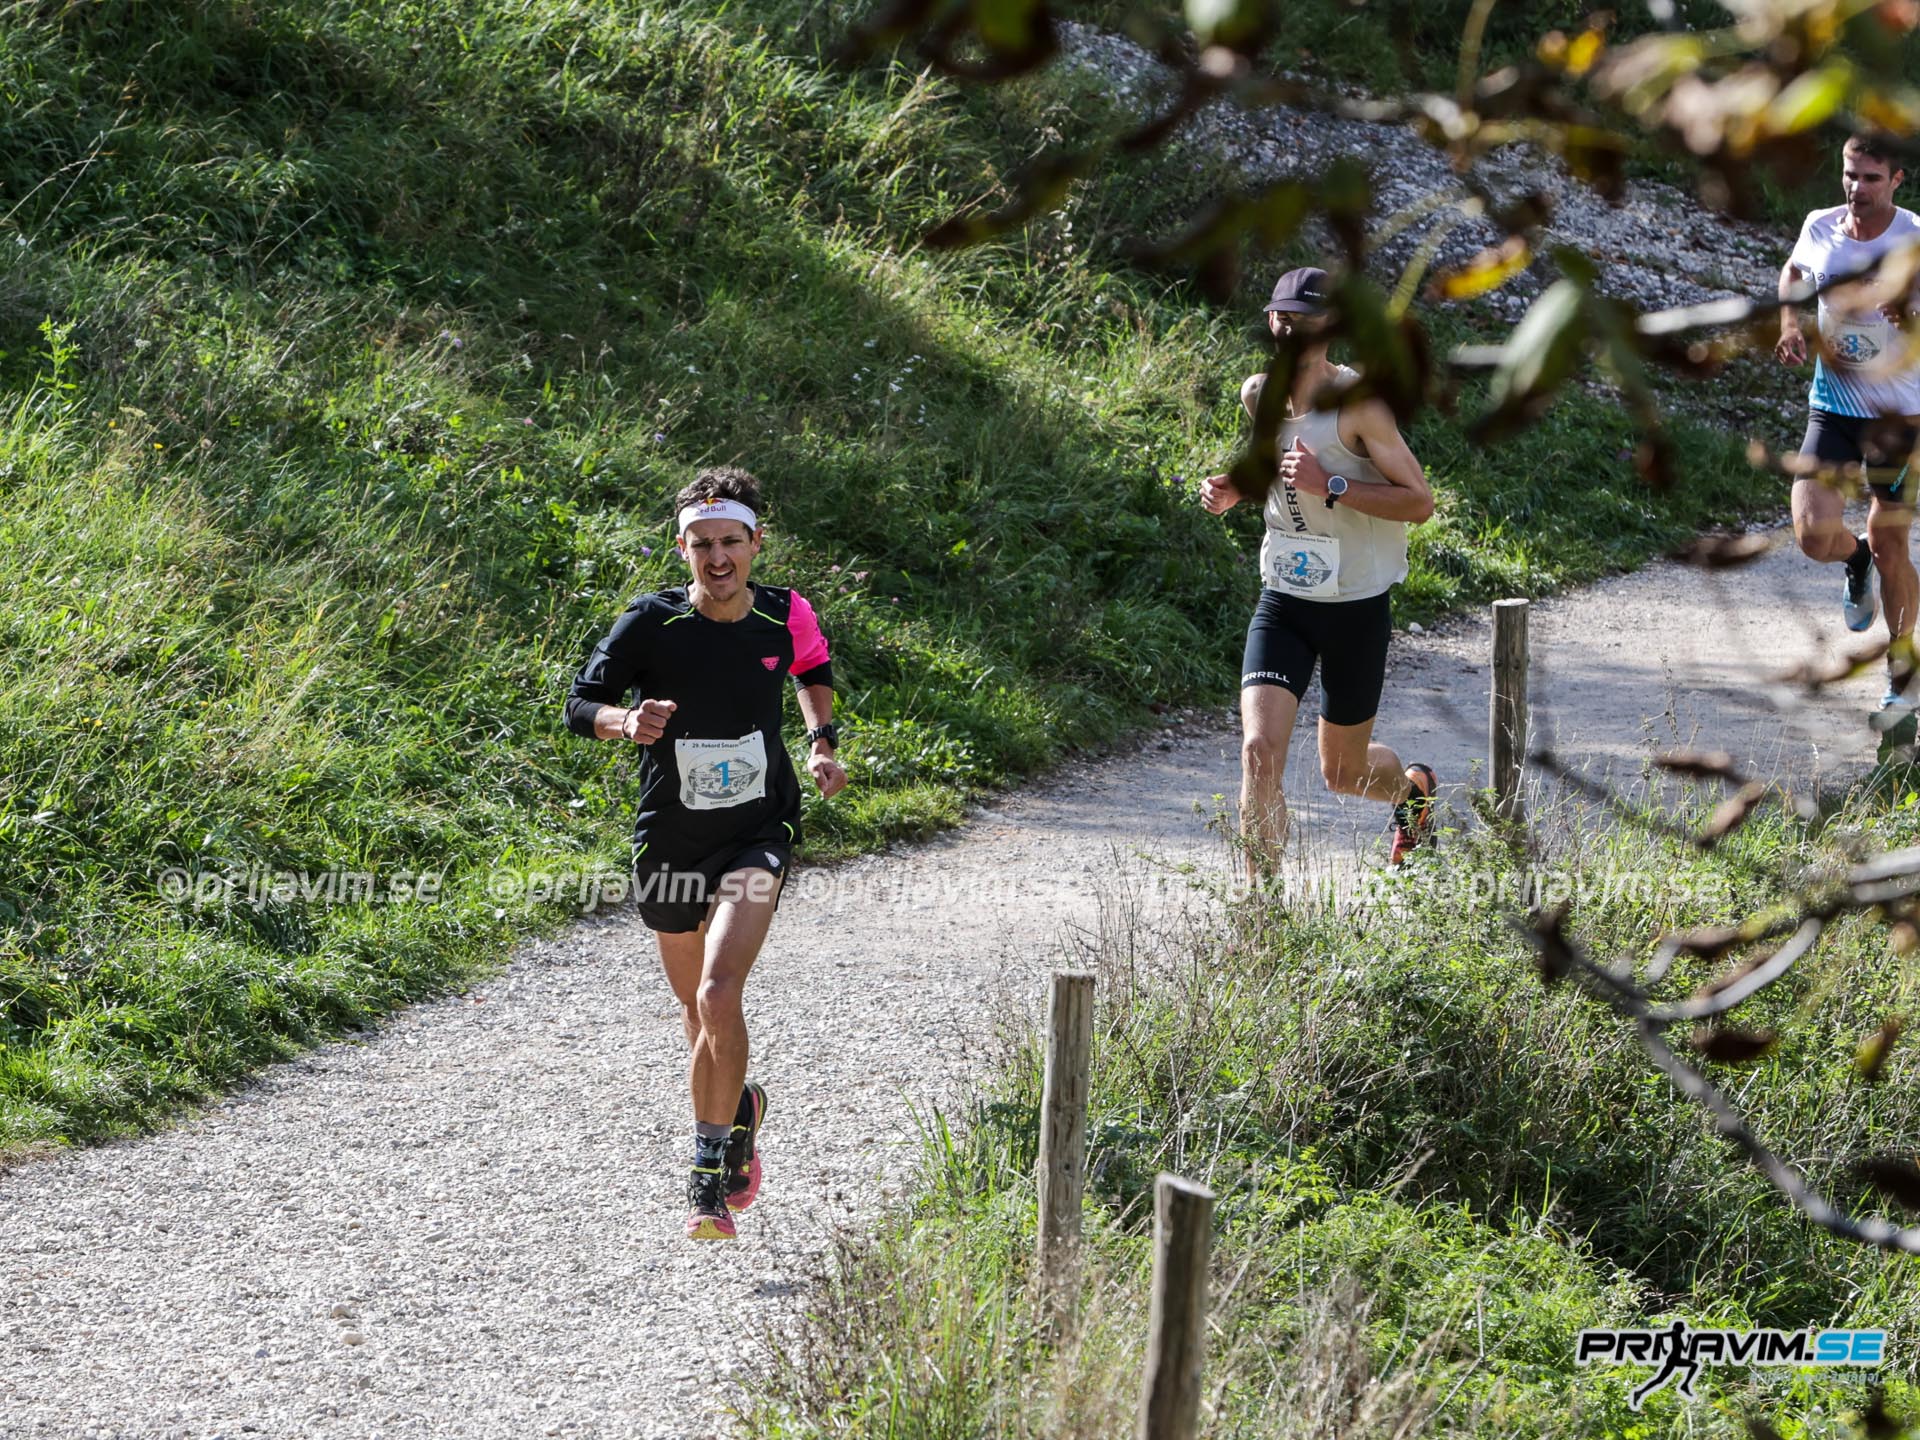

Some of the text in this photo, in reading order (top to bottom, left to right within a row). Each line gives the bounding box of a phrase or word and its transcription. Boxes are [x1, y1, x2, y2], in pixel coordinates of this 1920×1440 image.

[1846, 334, 1859, 353] 3
[1294, 551, 1308, 576] 2
[713, 761, 729, 787] 1
